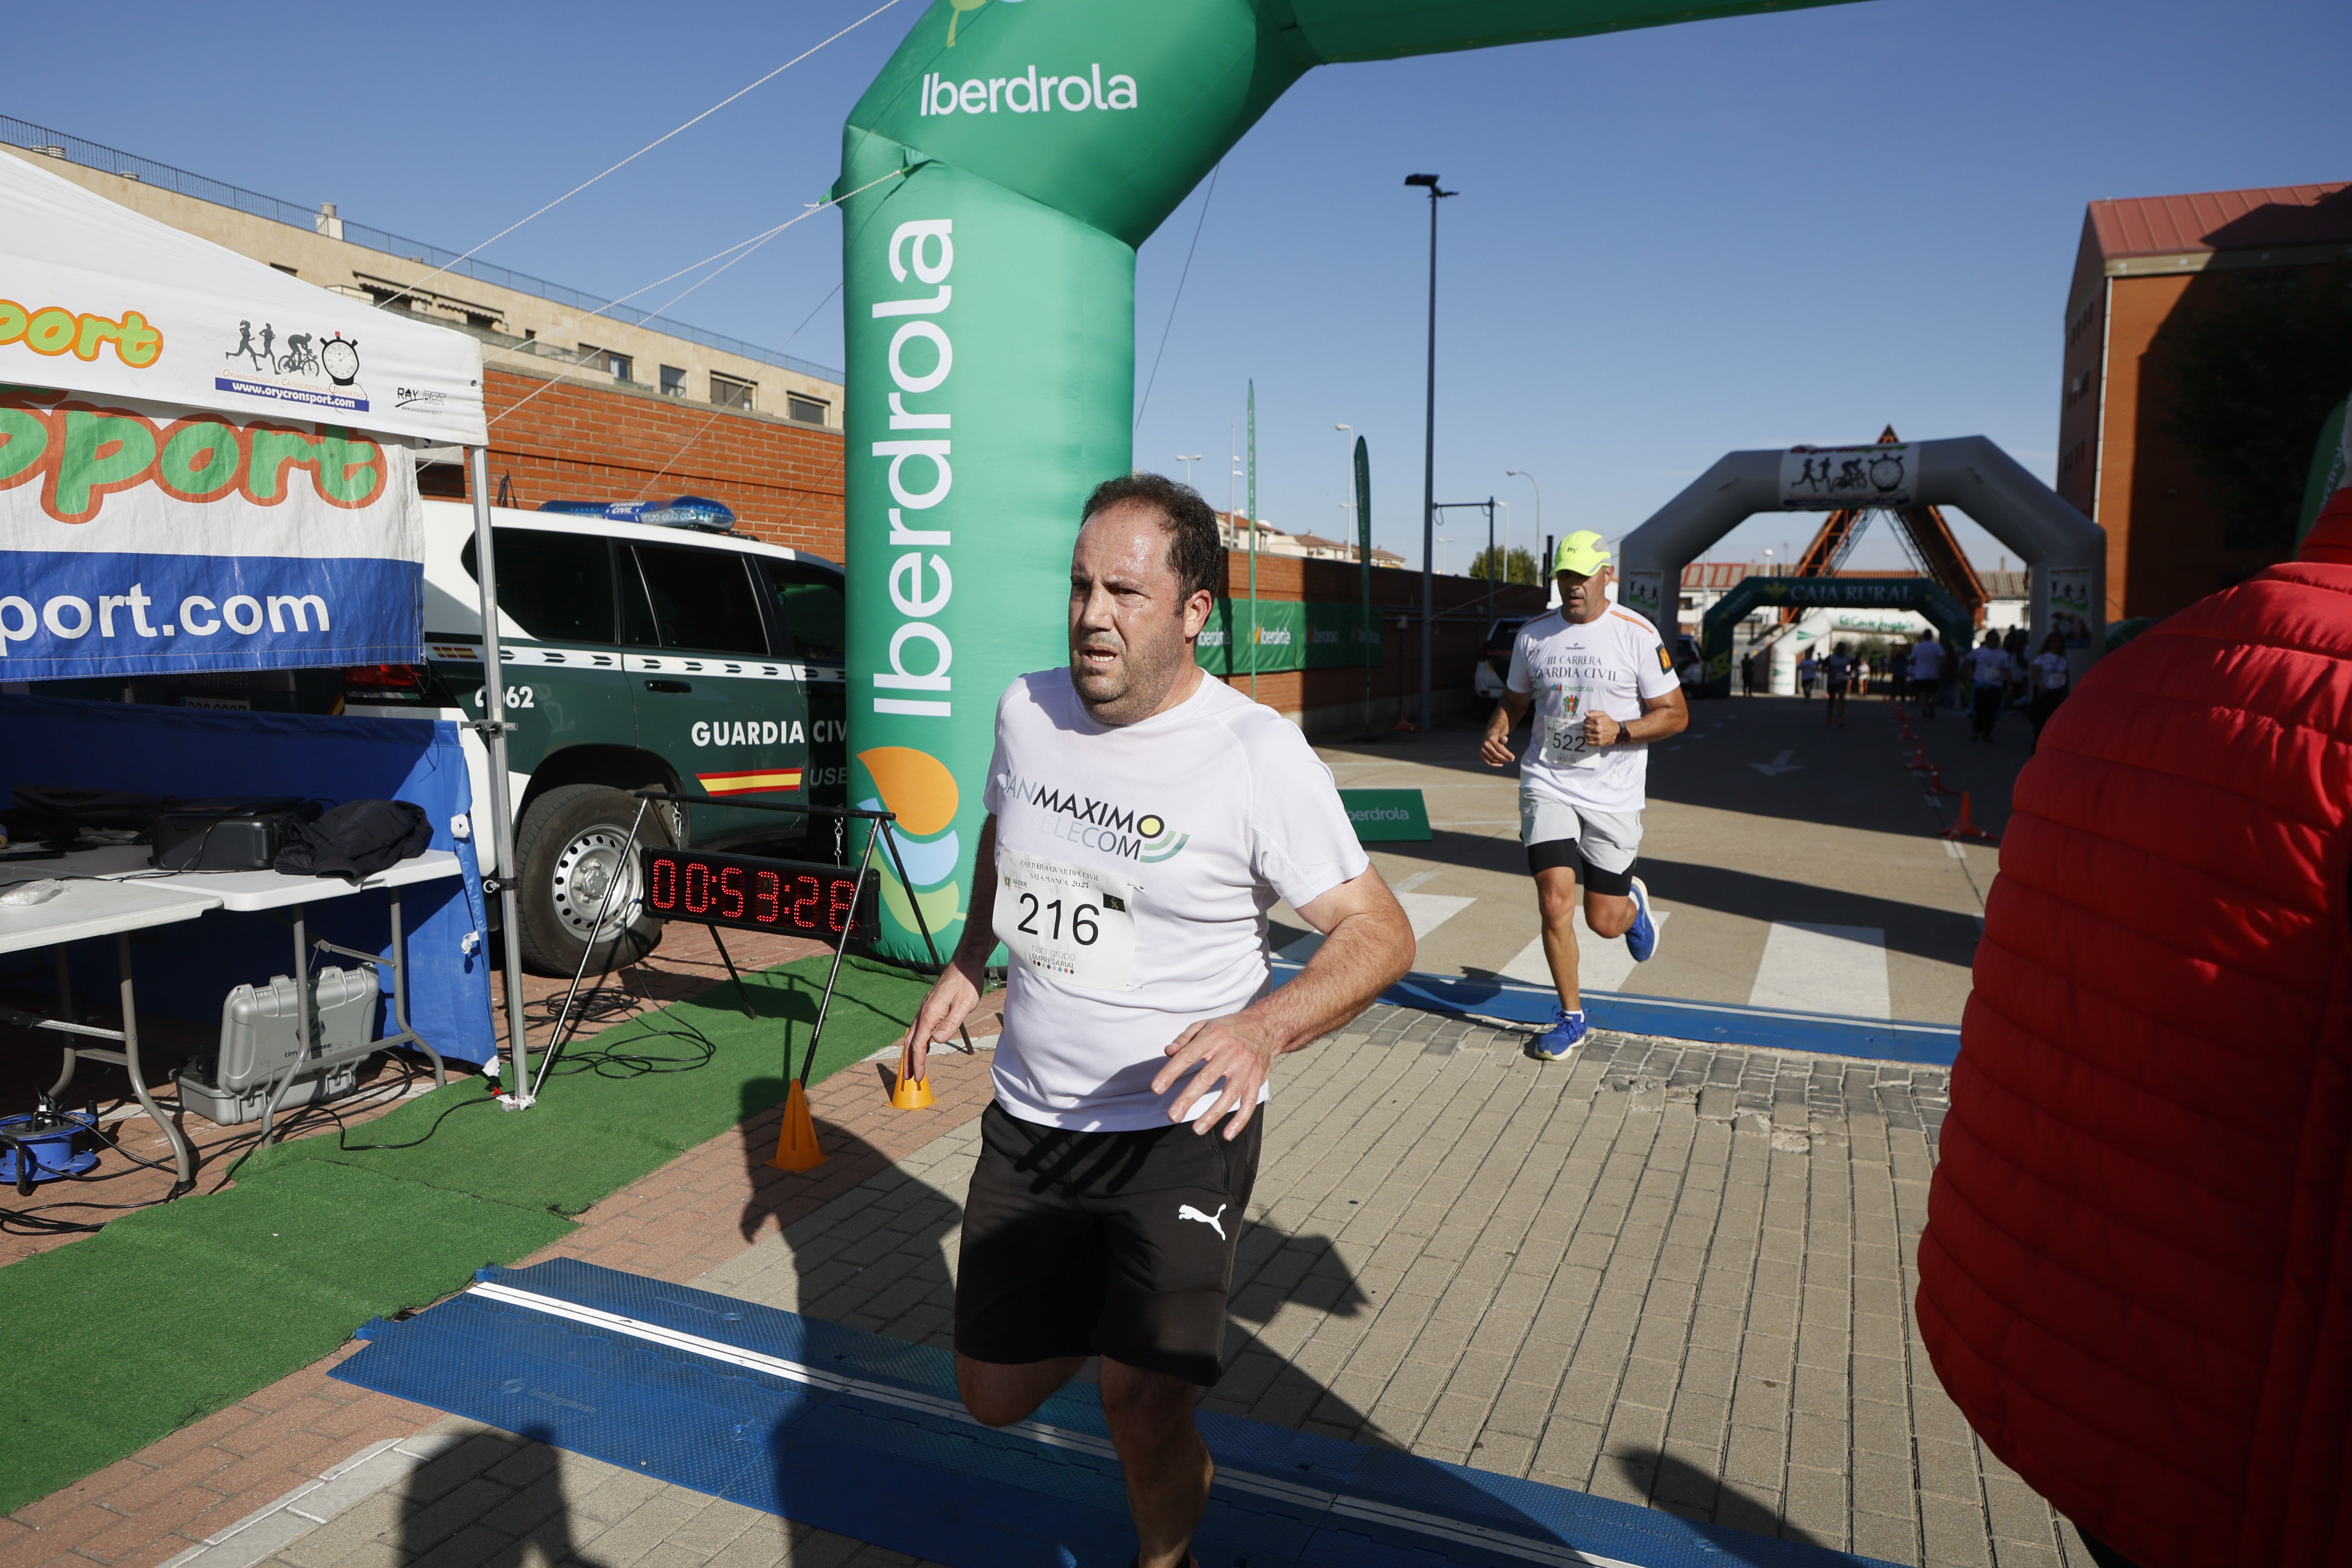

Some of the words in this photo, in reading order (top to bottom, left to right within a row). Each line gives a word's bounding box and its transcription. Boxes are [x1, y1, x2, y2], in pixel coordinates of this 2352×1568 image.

[921, 63, 1138, 116] Iberdrola
[232, 382, 355, 408] www.orycronsport.com
[398, 387, 419, 401] RAY
[872, 219, 953, 717] Iberdrola
[1790, 585, 1839, 603] CAJA
[1846, 585, 1913, 601] RURAL
[1261, 627, 1291, 645] Iberdrola
[1548, 656, 1556, 665] III
[1559, 655, 1602, 666] CARRERA
[1584, 668, 1618, 682] CIVIL
[502, 686, 534, 708] 62
[692, 720, 805, 747] GUARDIA
[1553, 732, 1586, 752] 522
[1038, 812, 1142, 861] ELECOM
[1020, 860, 1049, 872] CARRERA
[1012, 878, 1027, 888] ALCER
[1030, 873, 1069, 886] SALAMANCA
[1071, 880, 1090, 888] 2025
[1018, 893, 1100, 946] 216
[1032, 944, 1047, 955] nani
[1050, 949, 1076, 961] grupo
[1032, 953, 1075, 969] EMPRESARIAL
